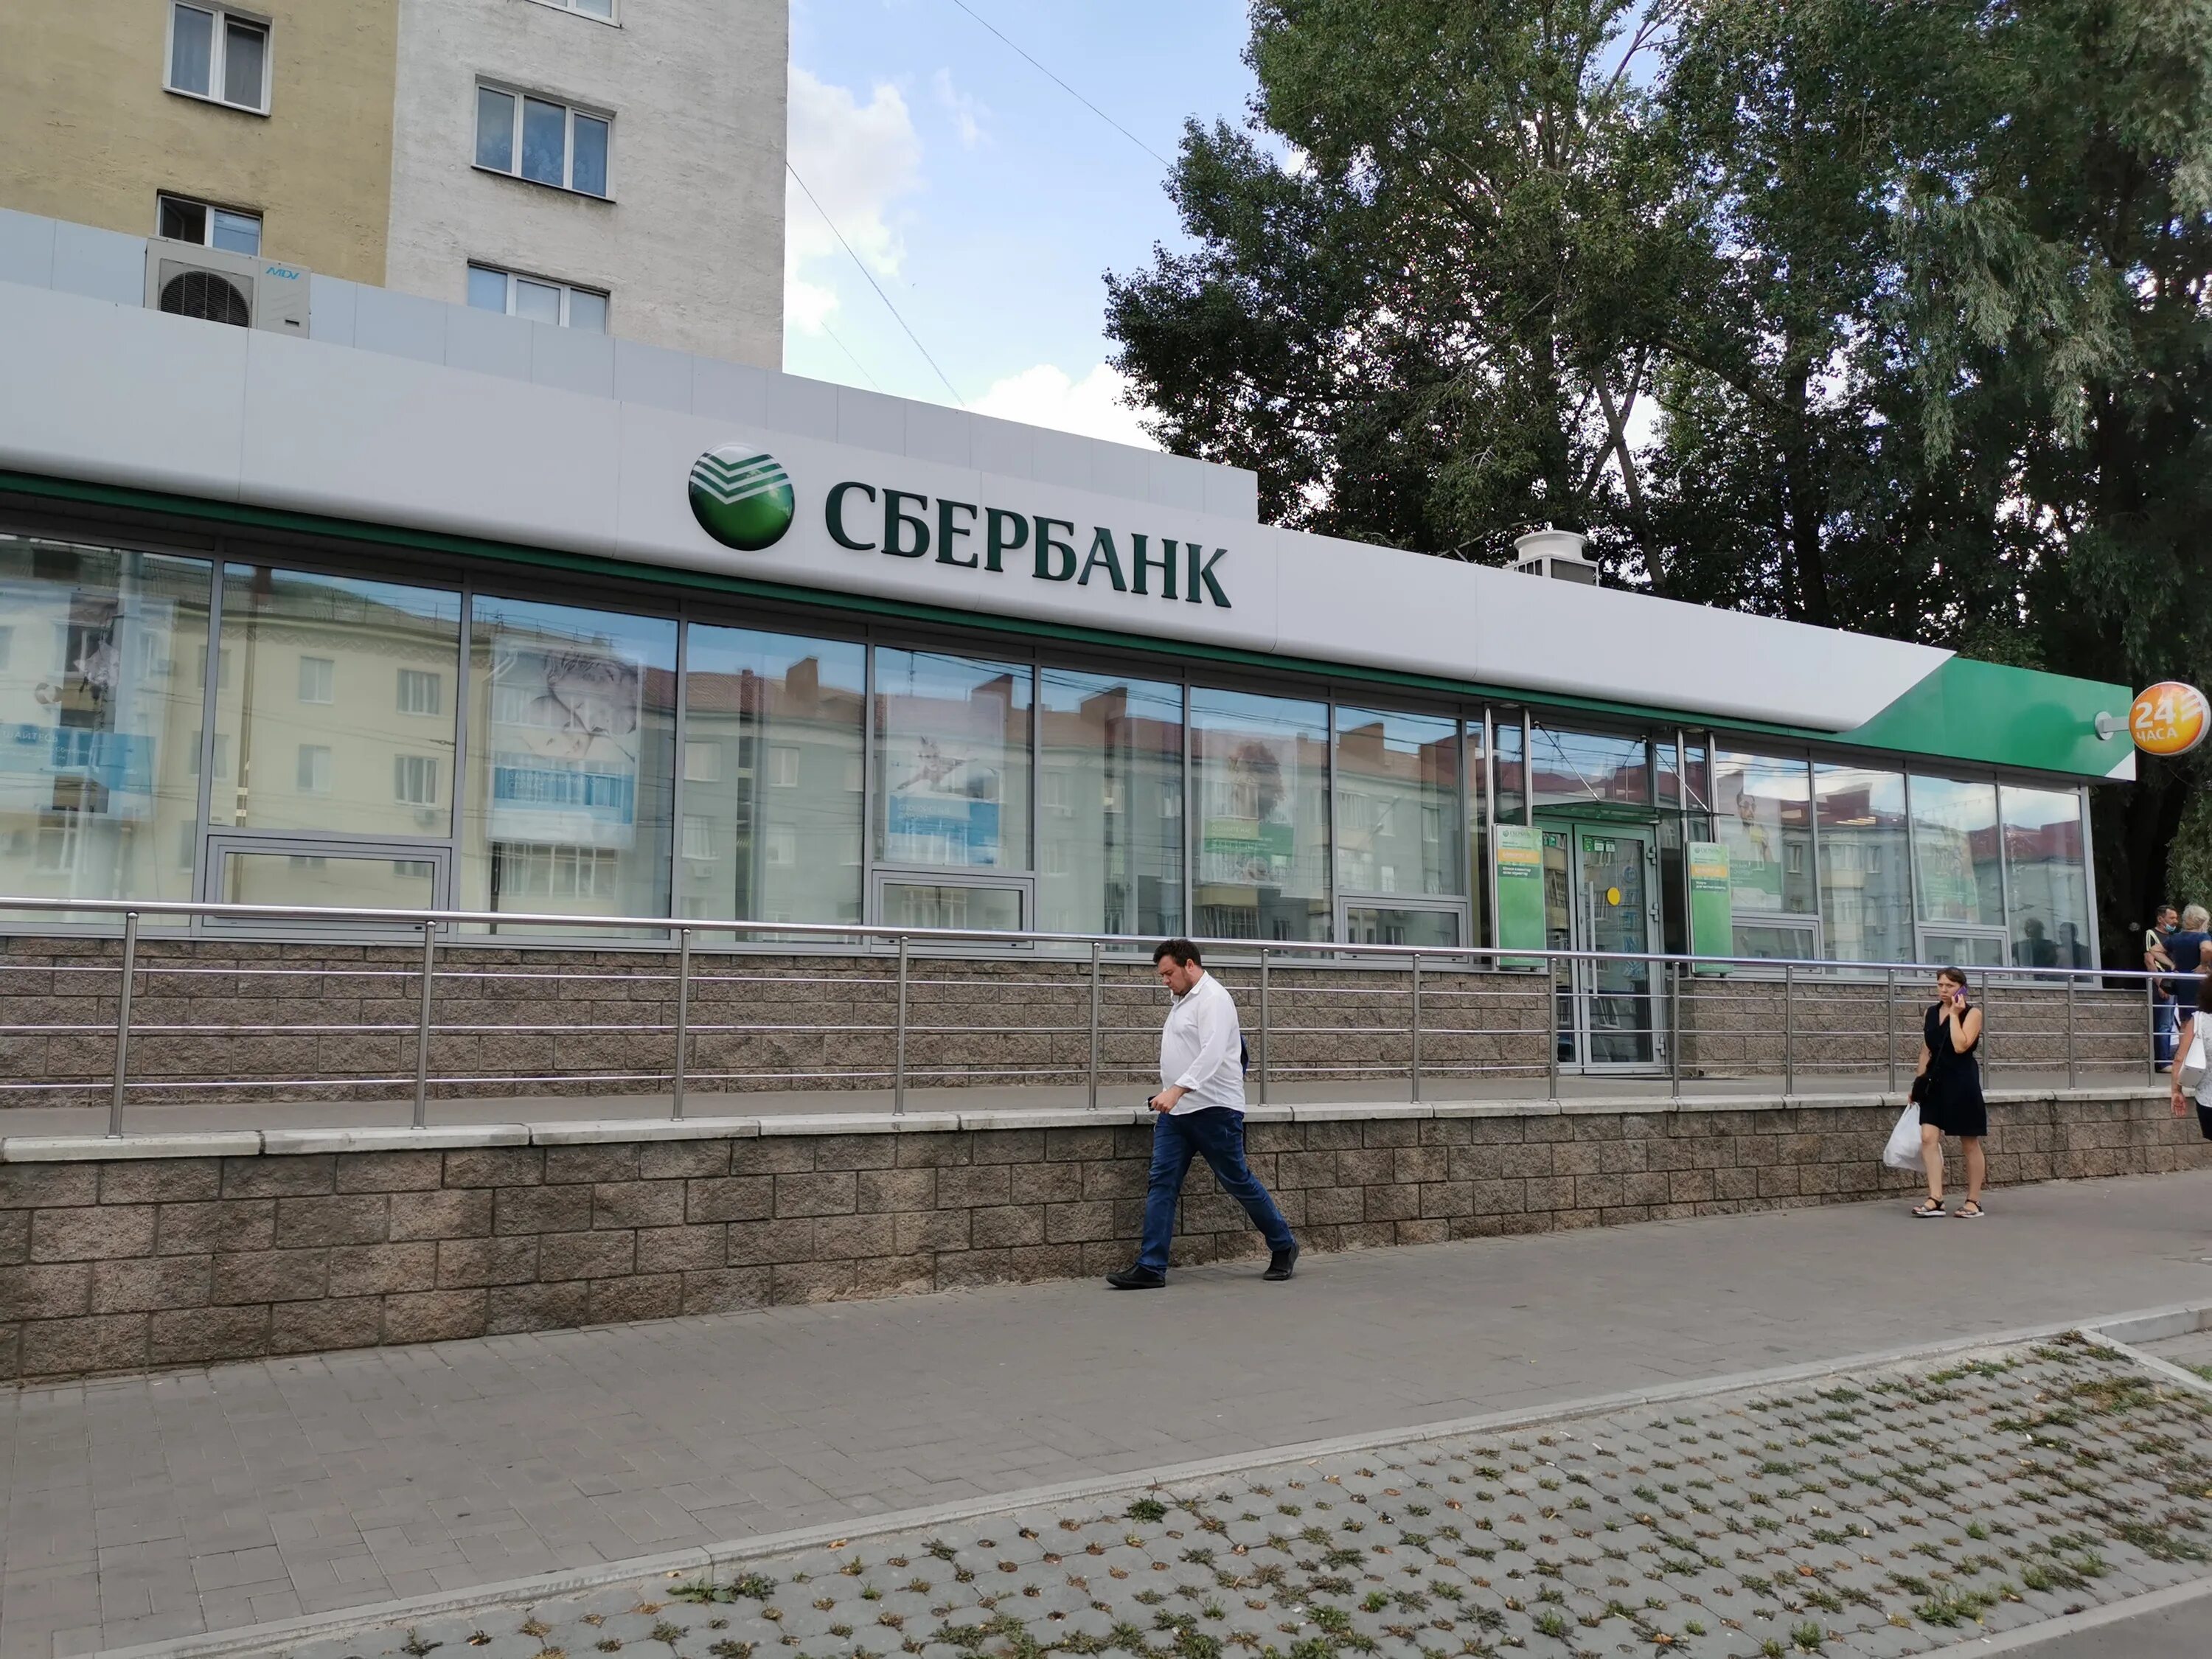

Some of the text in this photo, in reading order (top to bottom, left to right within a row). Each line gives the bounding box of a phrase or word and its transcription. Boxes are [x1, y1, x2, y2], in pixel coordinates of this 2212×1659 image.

[265, 266, 300, 280] MDV
[825, 481, 1232, 608] СБЕРБАНК
[2135, 698, 2177, 729] 24
[2136, 727, 2178, 743] ЧАСА
